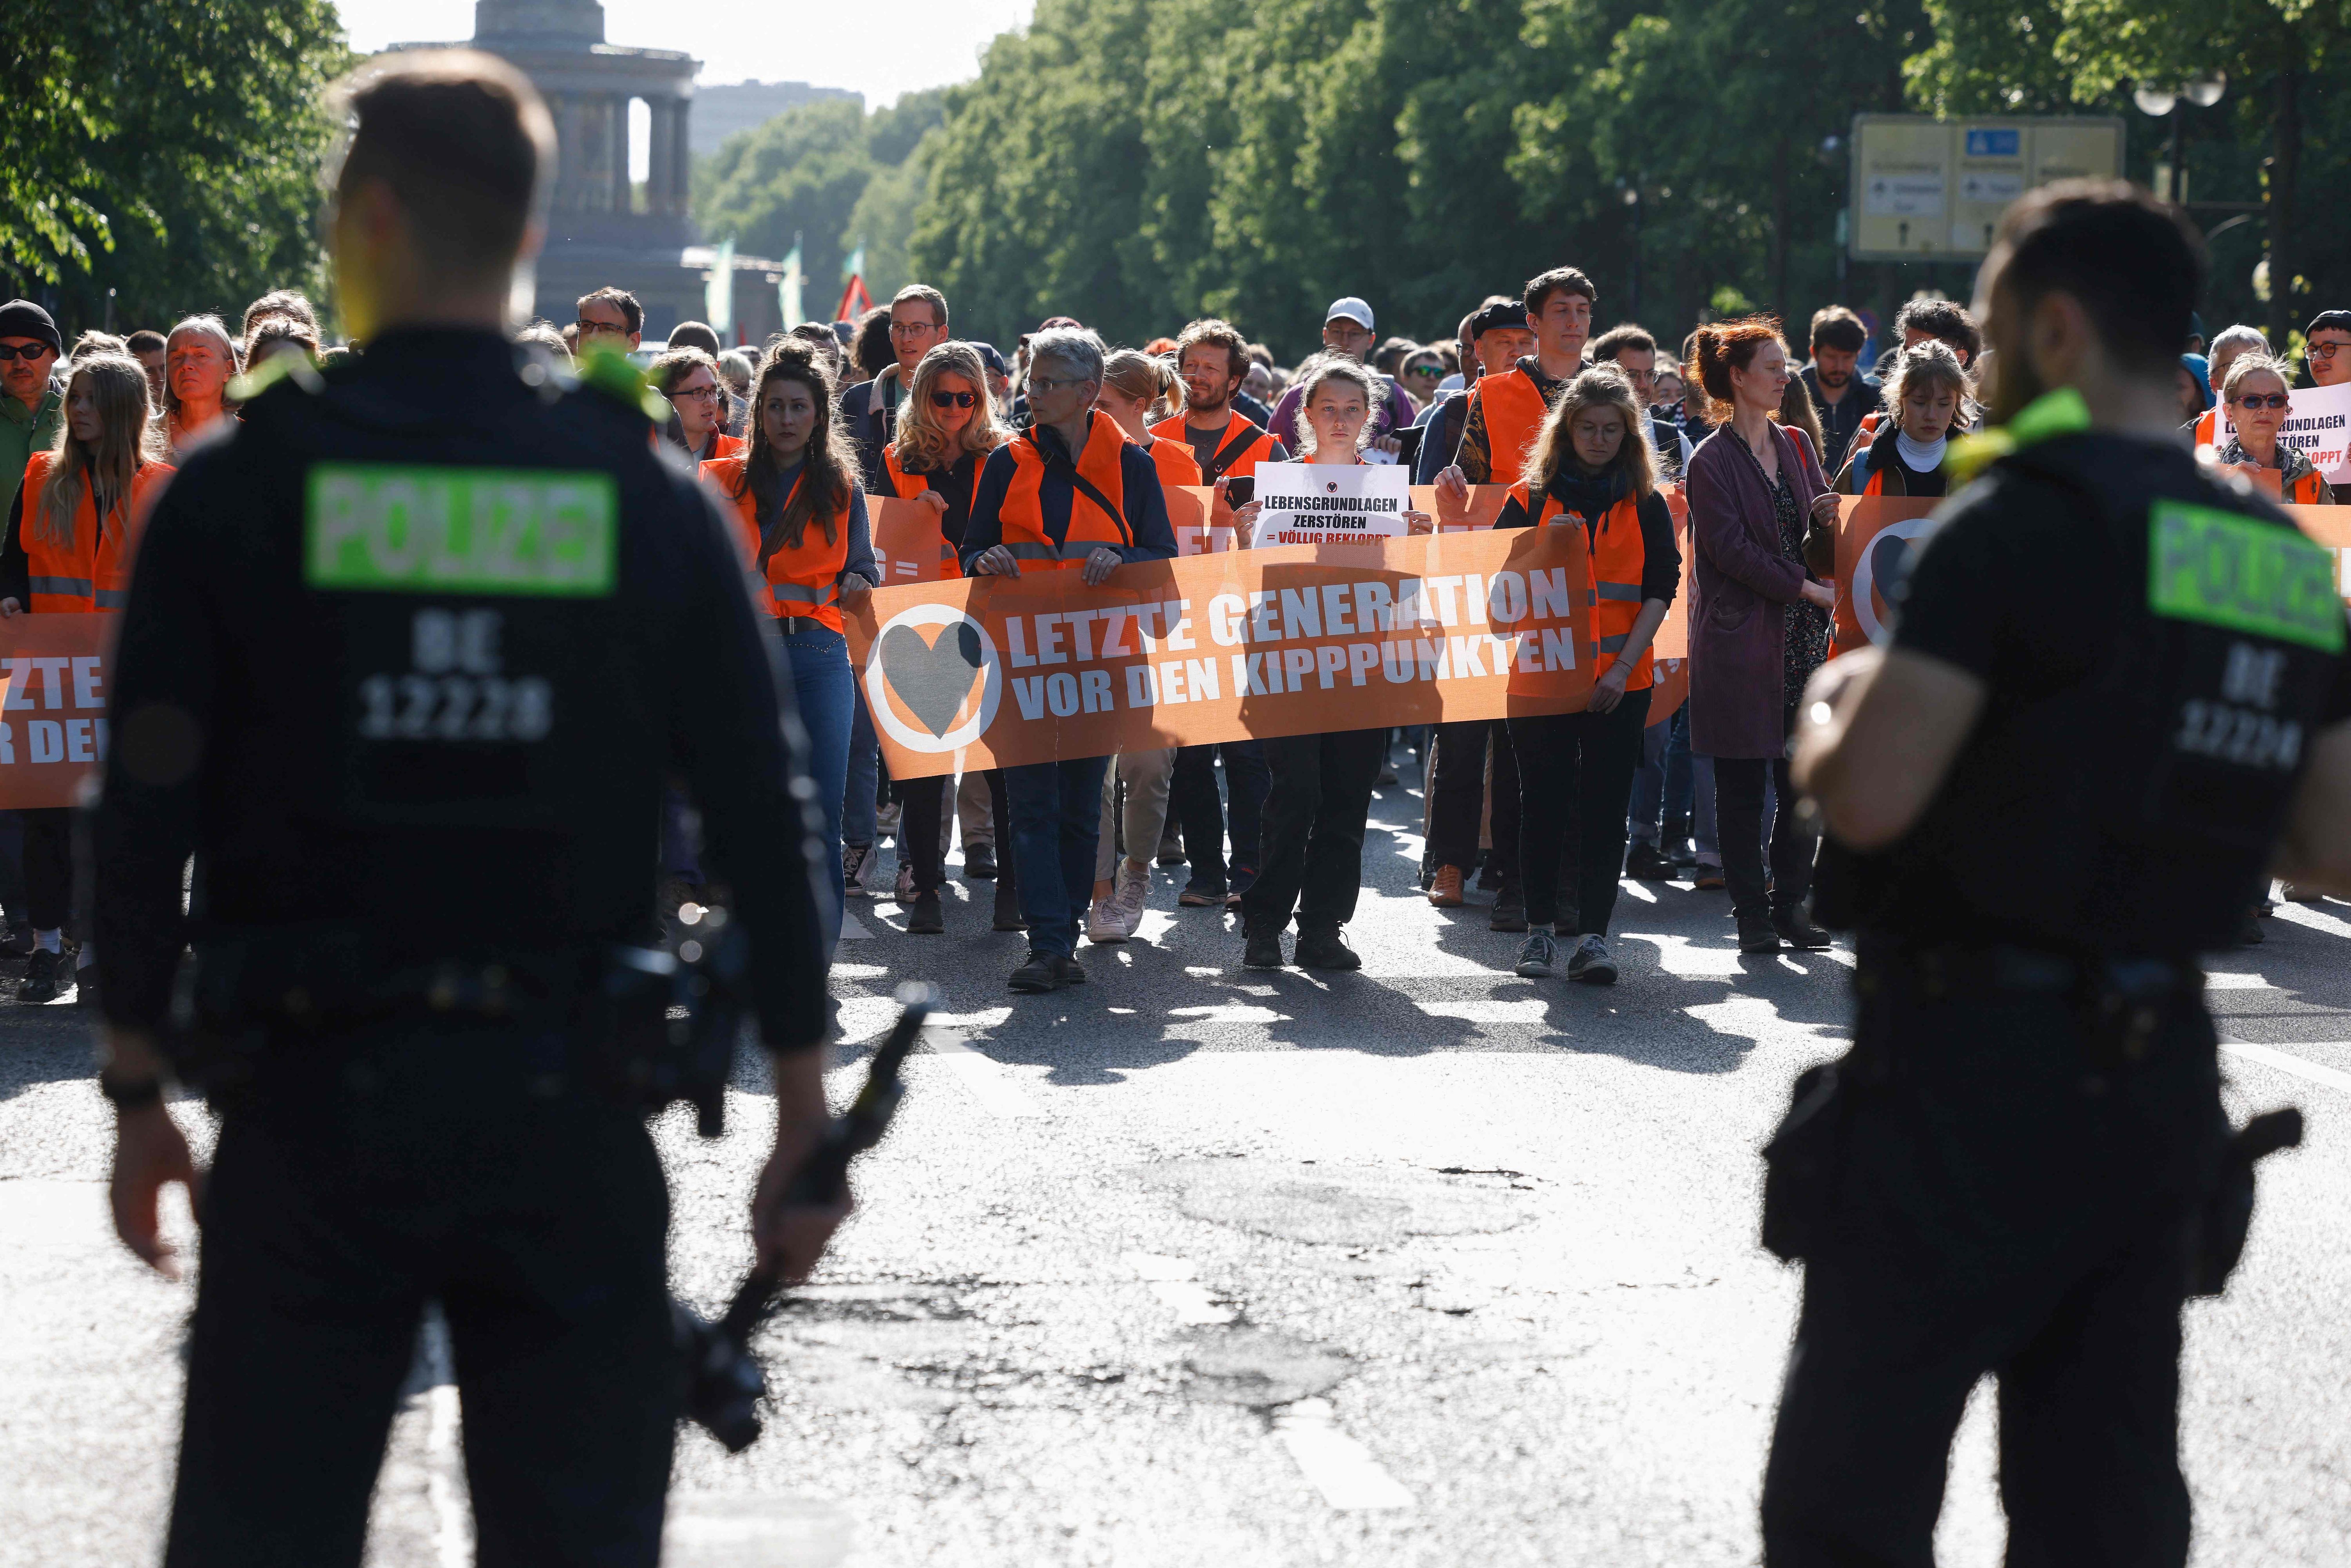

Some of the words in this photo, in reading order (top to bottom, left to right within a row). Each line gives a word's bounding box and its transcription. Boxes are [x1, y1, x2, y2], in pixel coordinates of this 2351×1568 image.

[1265, 496, 1397, 512] LEBENSGRUNDLAGEN
[1293, 514, 1366, 529] ZERSTÖREN
[1279, 530, 1322, 544] VÖLLIG
[1005, 599, 1196, 668] LETZTE
[1208, 567, 1570, 646] GENERATION
[0, 656, 106, 710] ZTE
[1011, 669, 1114, 721] VOR
[1125, 656, 1221, 708] DEN
[1231, 627, 1576, 697] KIPPPUNKTEN
